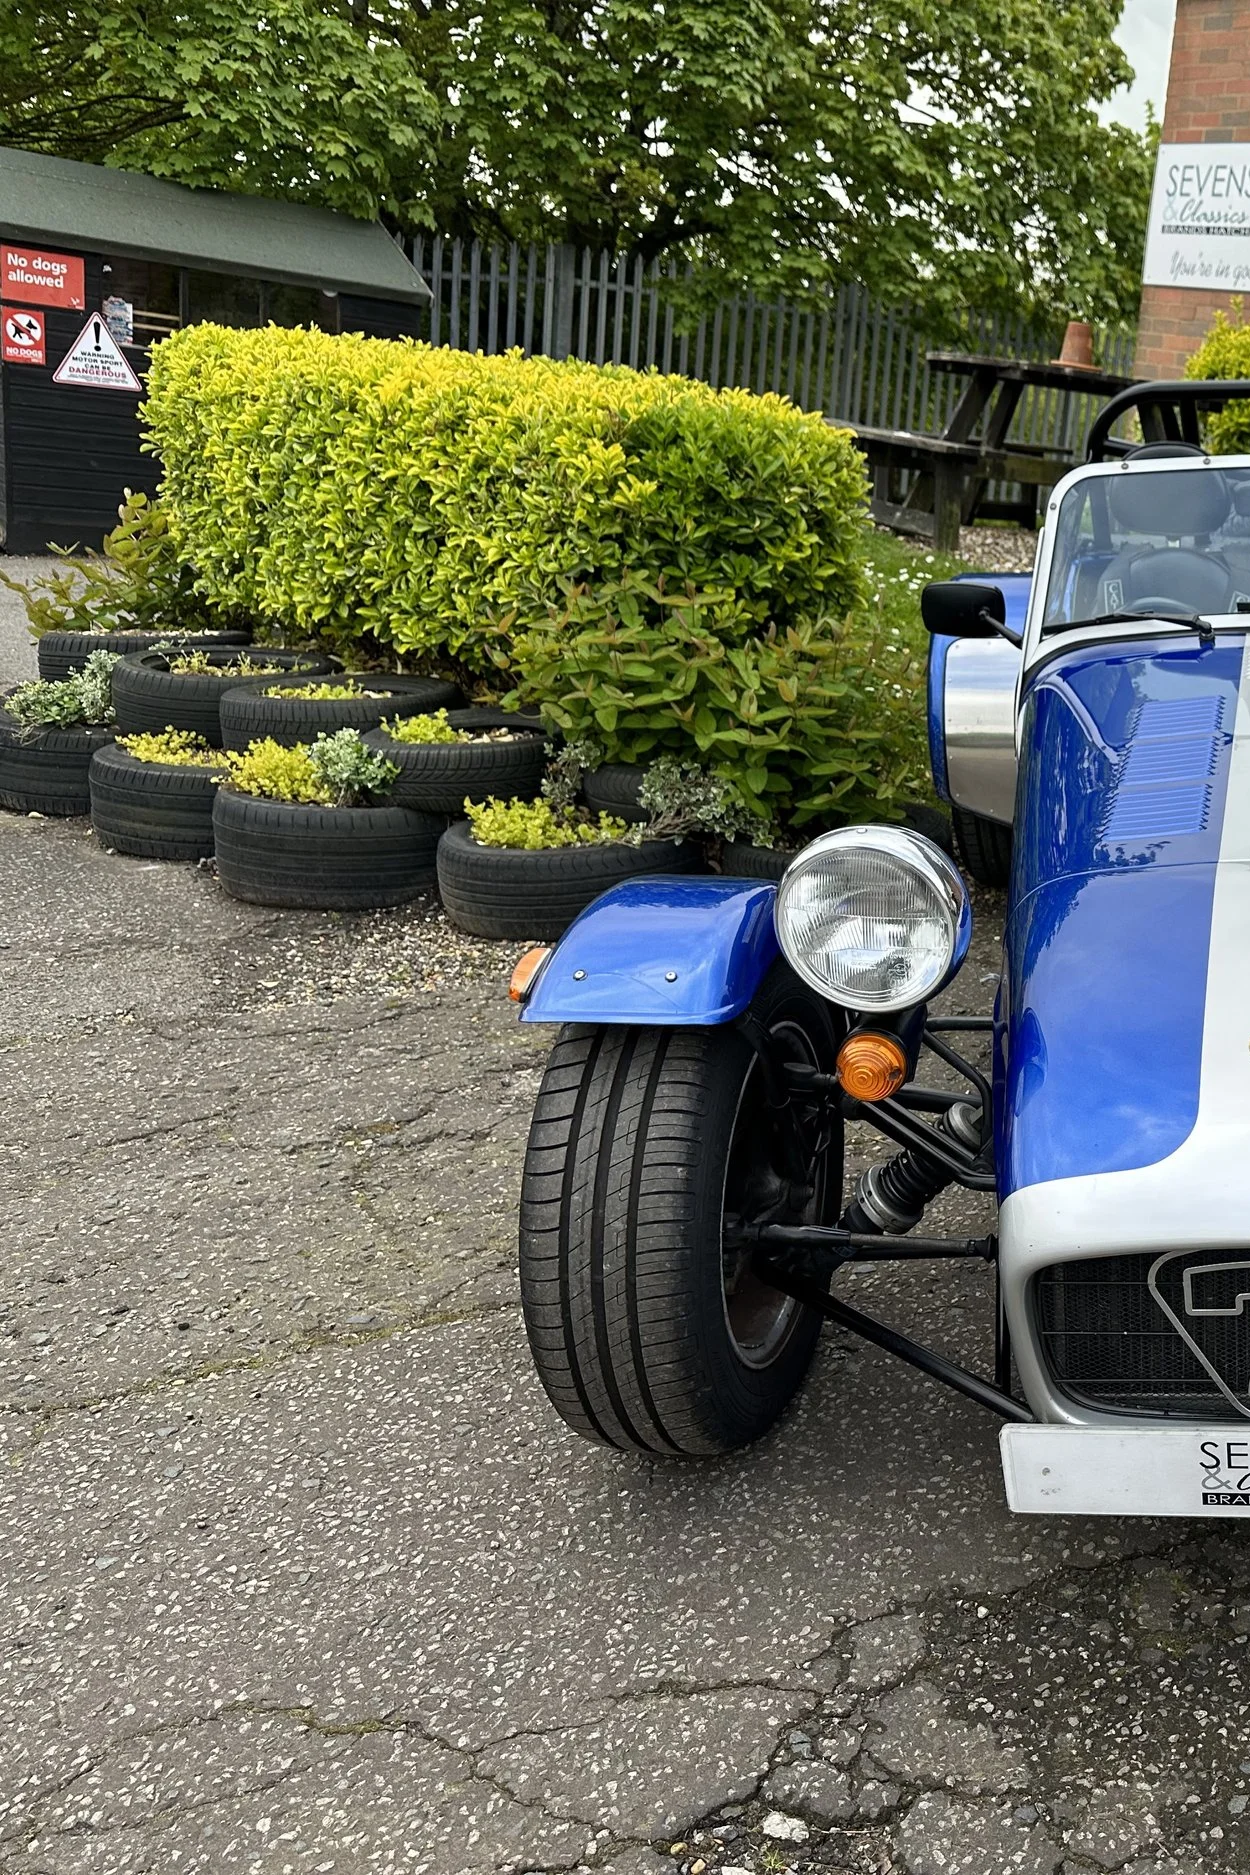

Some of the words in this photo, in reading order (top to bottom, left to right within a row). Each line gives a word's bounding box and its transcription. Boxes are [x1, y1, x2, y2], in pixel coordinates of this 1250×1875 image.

[1179, 199, 1249, 225] Classics
[1163, 225, 1207, 236] BRANDS
[1208, 226, 1250, 237] HATCH
[7, 252, 28, 268] No
[32, 256, 68, 276] dogs
[1169, 250, 1213, 281] You're
[1214, 258, 1231, 278] in
[8, 268, 64, 289] allowed
[6, 346, 19, 357] NO
[20, 347, 43, 359] DOGS
[72, 355, 99, 363] MOTOR
[100, 358, 123, 367] SPORT
[80, 350, 115, 360] WARNING
[69, 366, 127, 379] DANGEROUS
[1201, 1466, 1233, 1490] &
